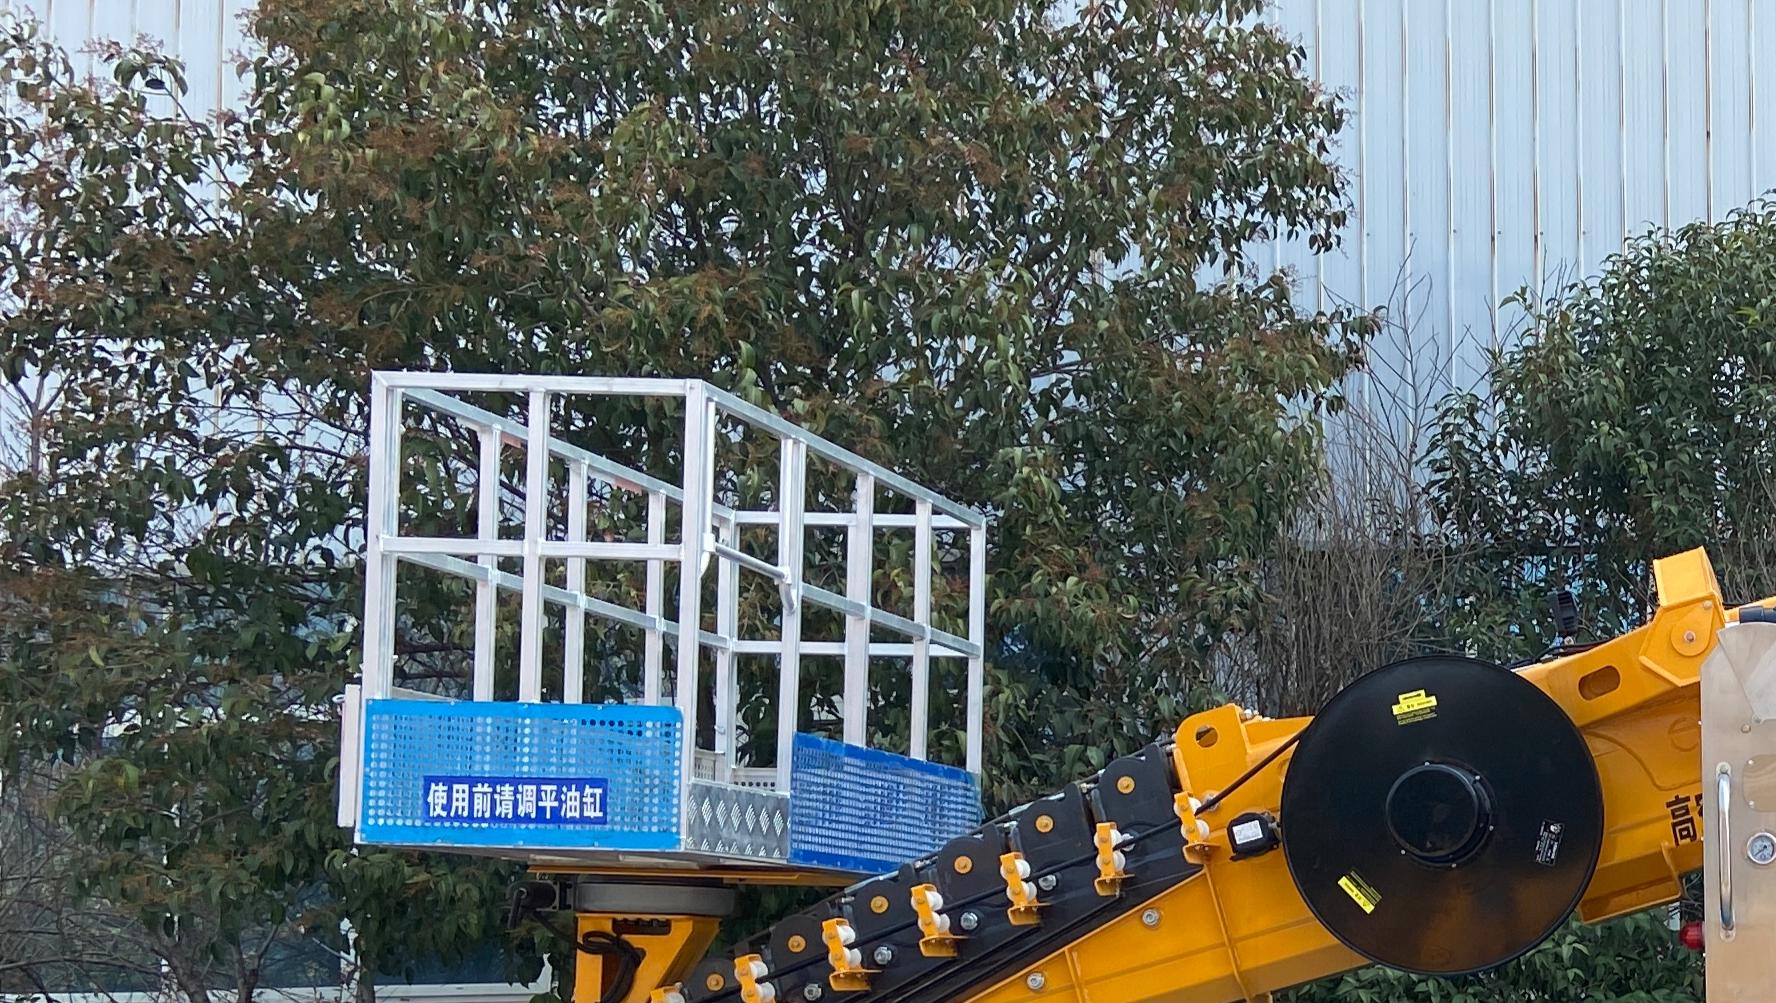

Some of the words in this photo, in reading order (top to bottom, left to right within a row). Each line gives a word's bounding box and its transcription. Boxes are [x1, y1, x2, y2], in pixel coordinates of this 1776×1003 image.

[427, 782, 604, 819] 使用前请调平油缸
